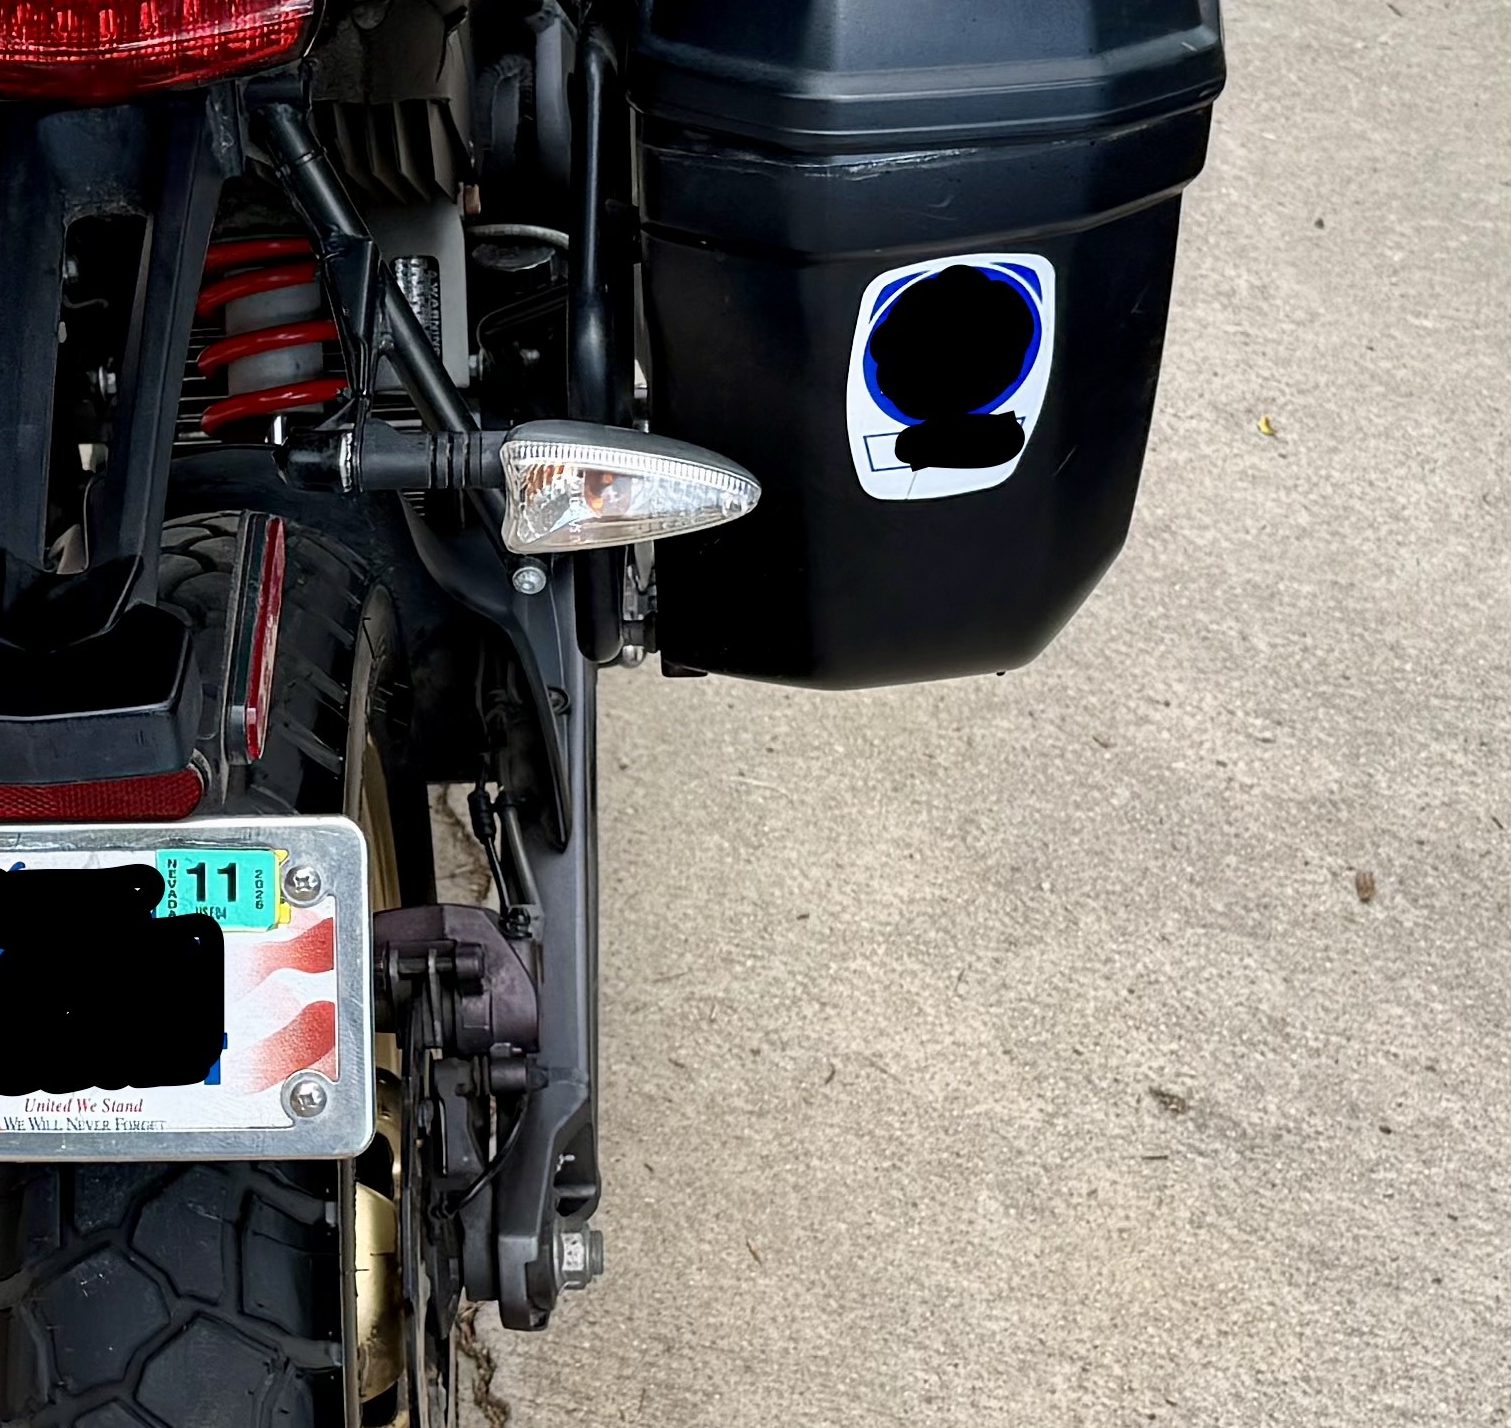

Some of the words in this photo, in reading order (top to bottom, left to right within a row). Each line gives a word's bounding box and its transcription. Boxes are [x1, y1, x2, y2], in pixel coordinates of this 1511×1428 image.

[167, 858, 178, 917] NEVADA
[186, 862, 237, 903] 11
[24, 1097, 72, 1113] United
[77, 1098, 97, 1113] We
[101, 1098, 144, 1113] Stand
